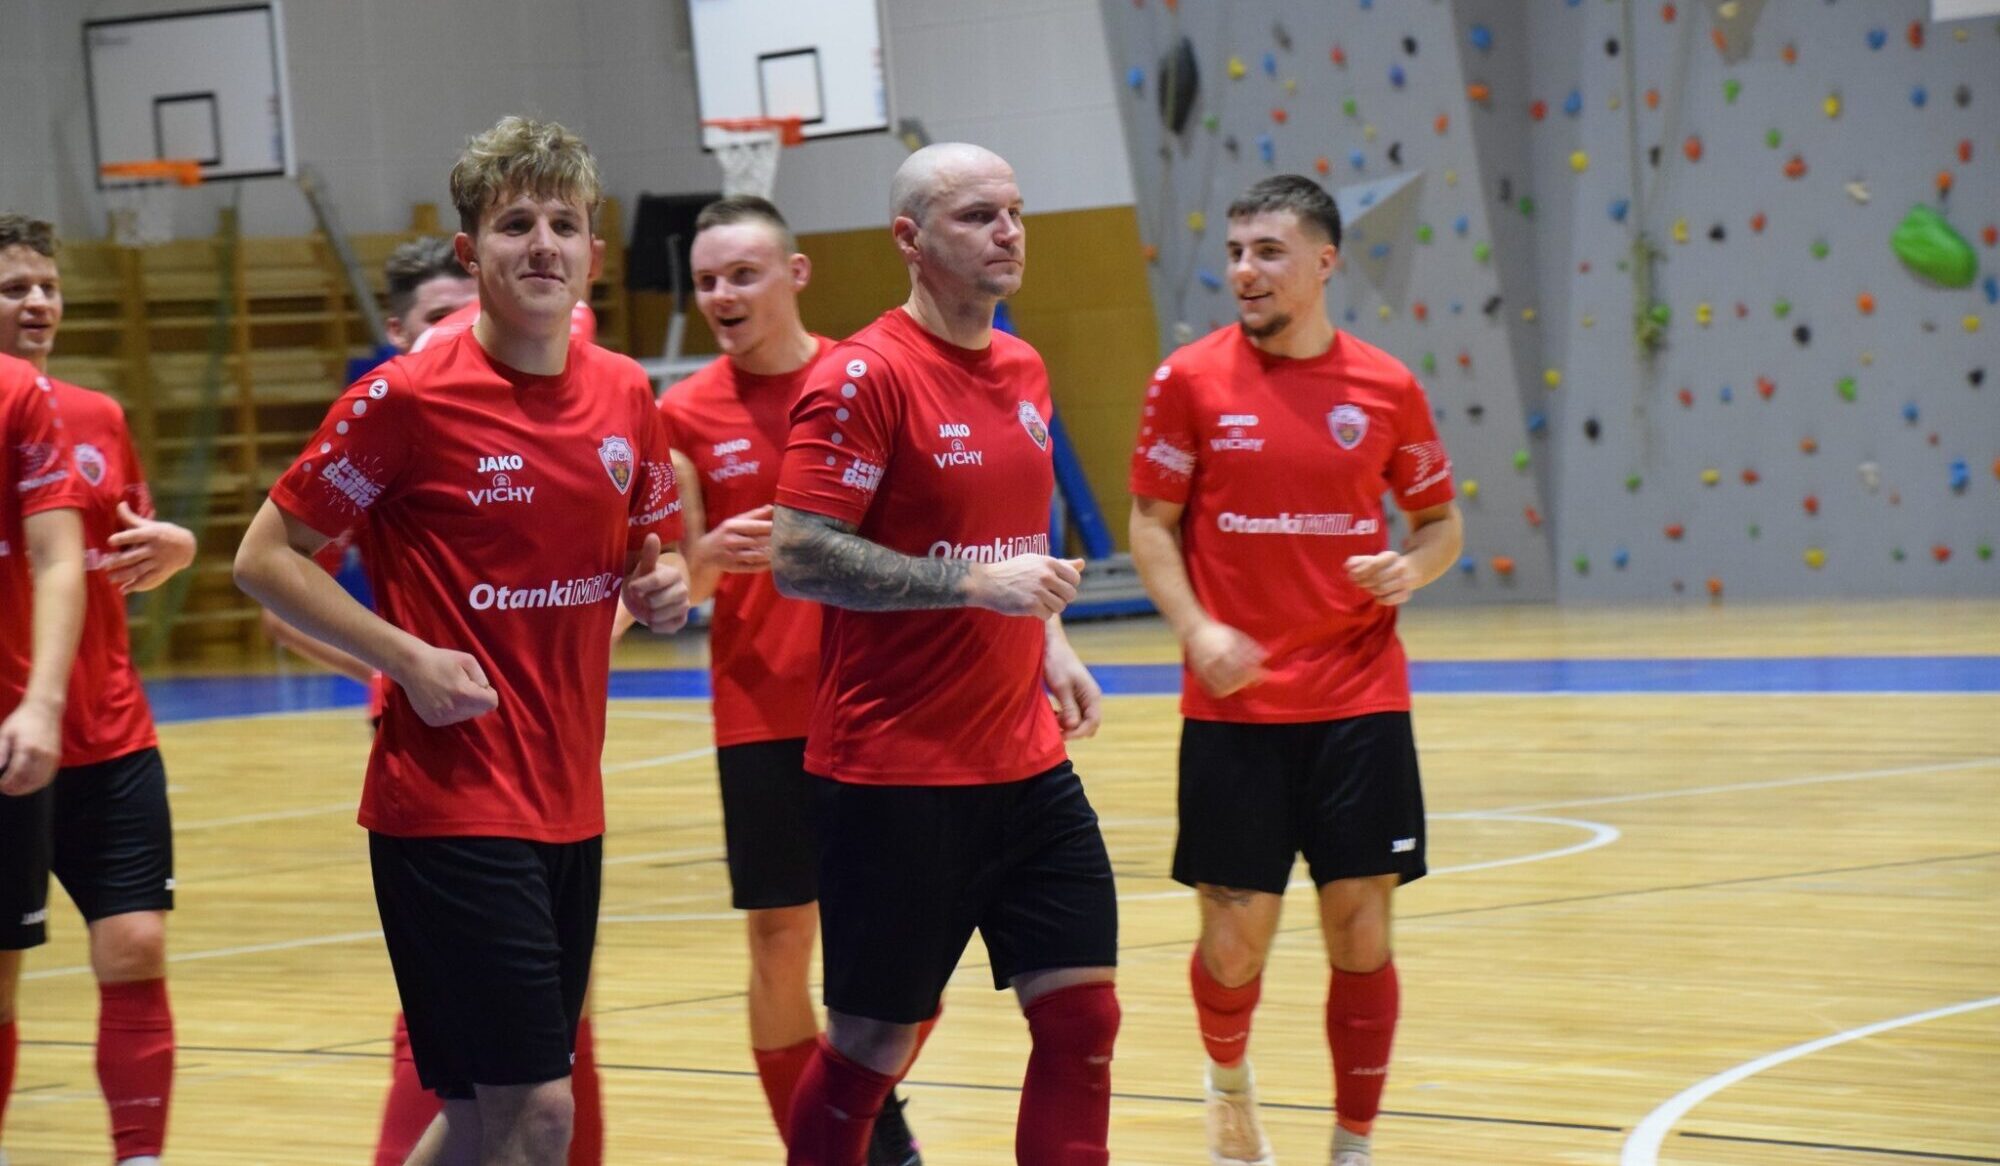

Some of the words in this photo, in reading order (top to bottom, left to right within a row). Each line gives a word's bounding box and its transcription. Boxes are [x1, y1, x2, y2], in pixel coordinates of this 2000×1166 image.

[938, 423, 971, 438] JAKO
[477, 454, 524, 473] JAKO
[933, 450, 983, 469] VICHY
[466, 486, 535, 507] VICHY
